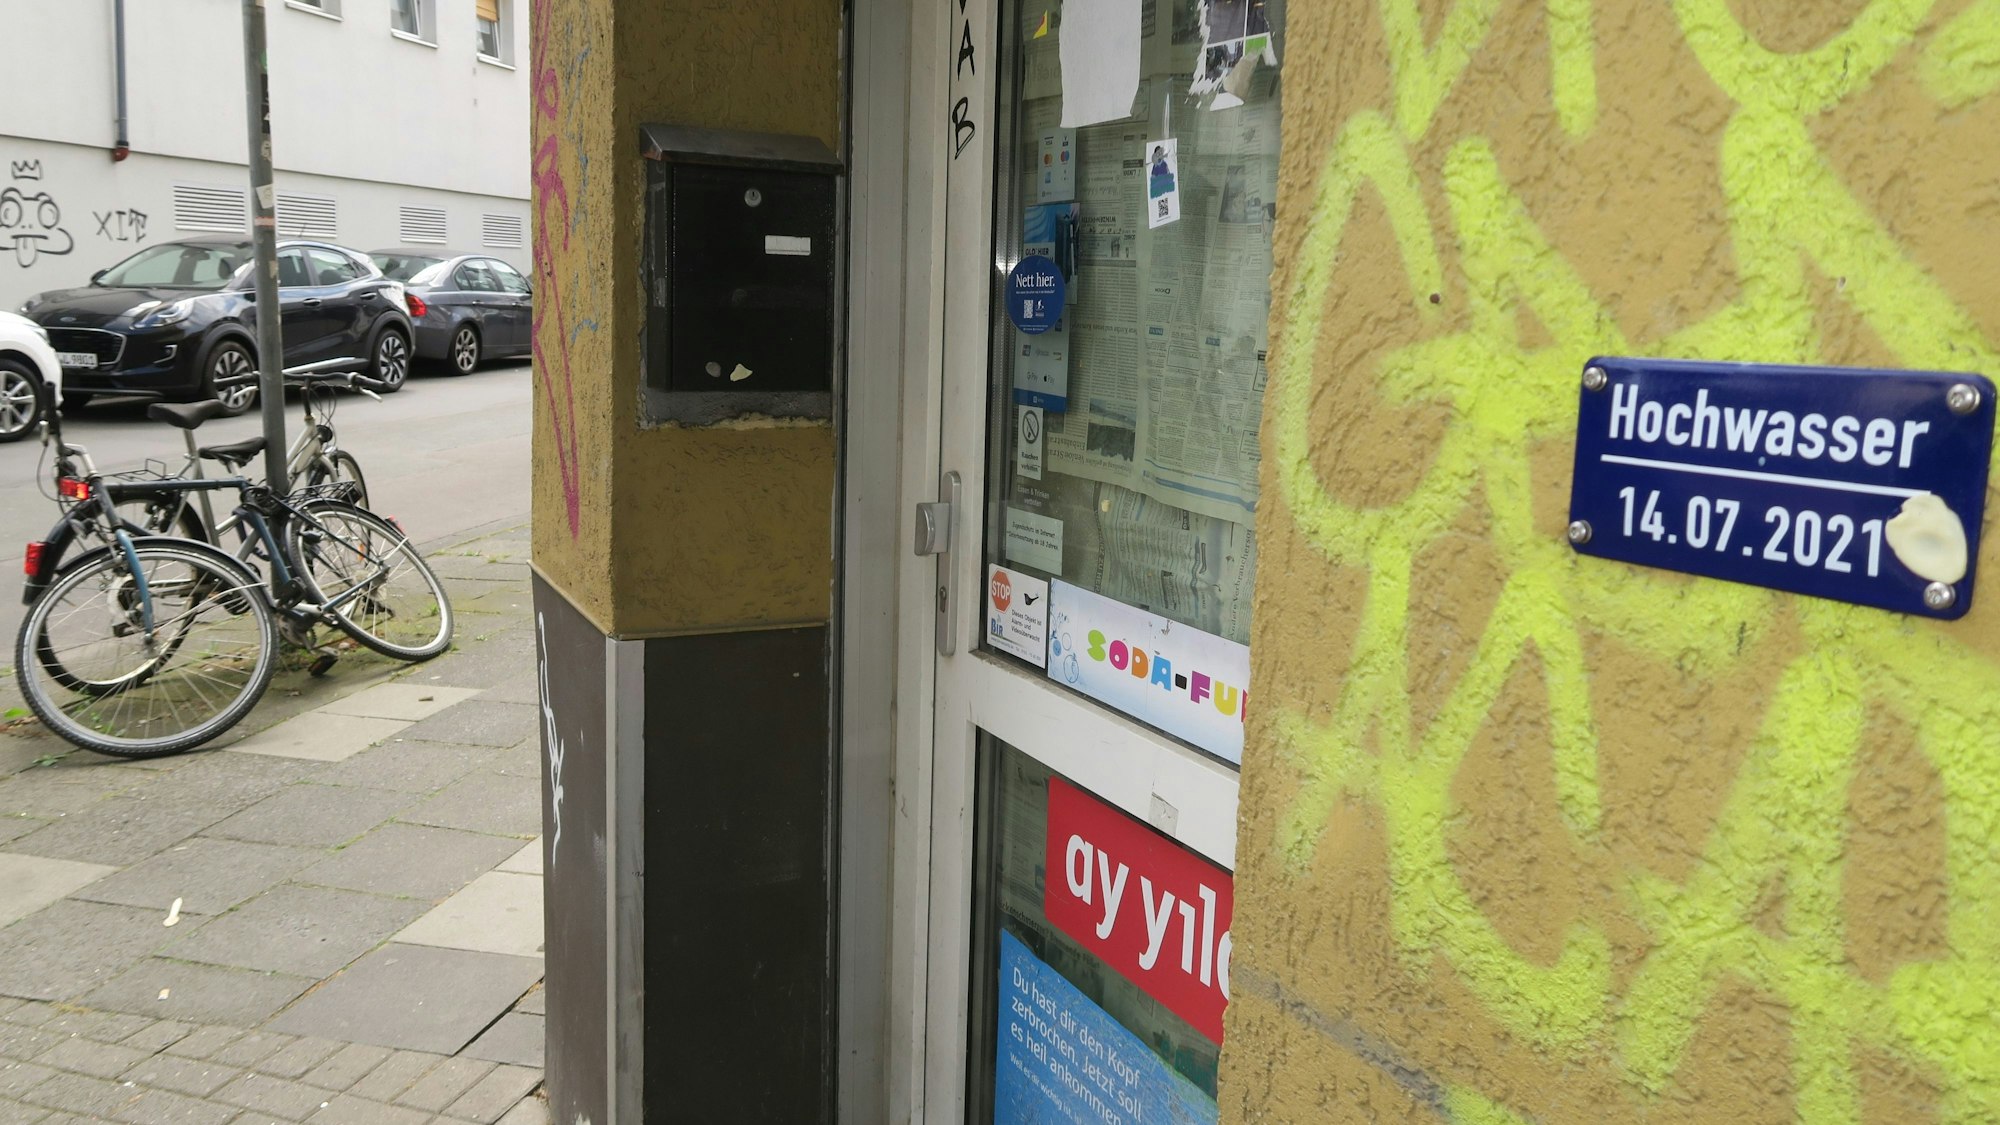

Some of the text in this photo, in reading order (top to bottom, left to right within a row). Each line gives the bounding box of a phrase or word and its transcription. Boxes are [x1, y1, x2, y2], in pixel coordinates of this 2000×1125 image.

[952, 0, 976, 160] AB
[1015, 271, 1055, 288] Nett hier.
[1608, 382, 1930, 469] Hochwasser
[1618, 485, 1883, 578] 14.07.2021
[992, 580, 1011, 601] STOP
[1011, 609, 1024, 620] Dieses
[1086, 628, 1250, 723] SODA-FU
[1065, 834, 1130, 940] ay
[1010, 1022, 1023, 1043] es
[1026, 1029, 1047, 1066] heil
[1011, 996, 1142, 1123] zerbrochen. Jetzt soll
[1013, 966, 1141, 1090] Du hast dir den Kopf
[1010, 1051, 1023, 1072] Weil
[1023, 1066, 1031, 1079] es
[1040, 1082, 1063, 1111] wichtig
